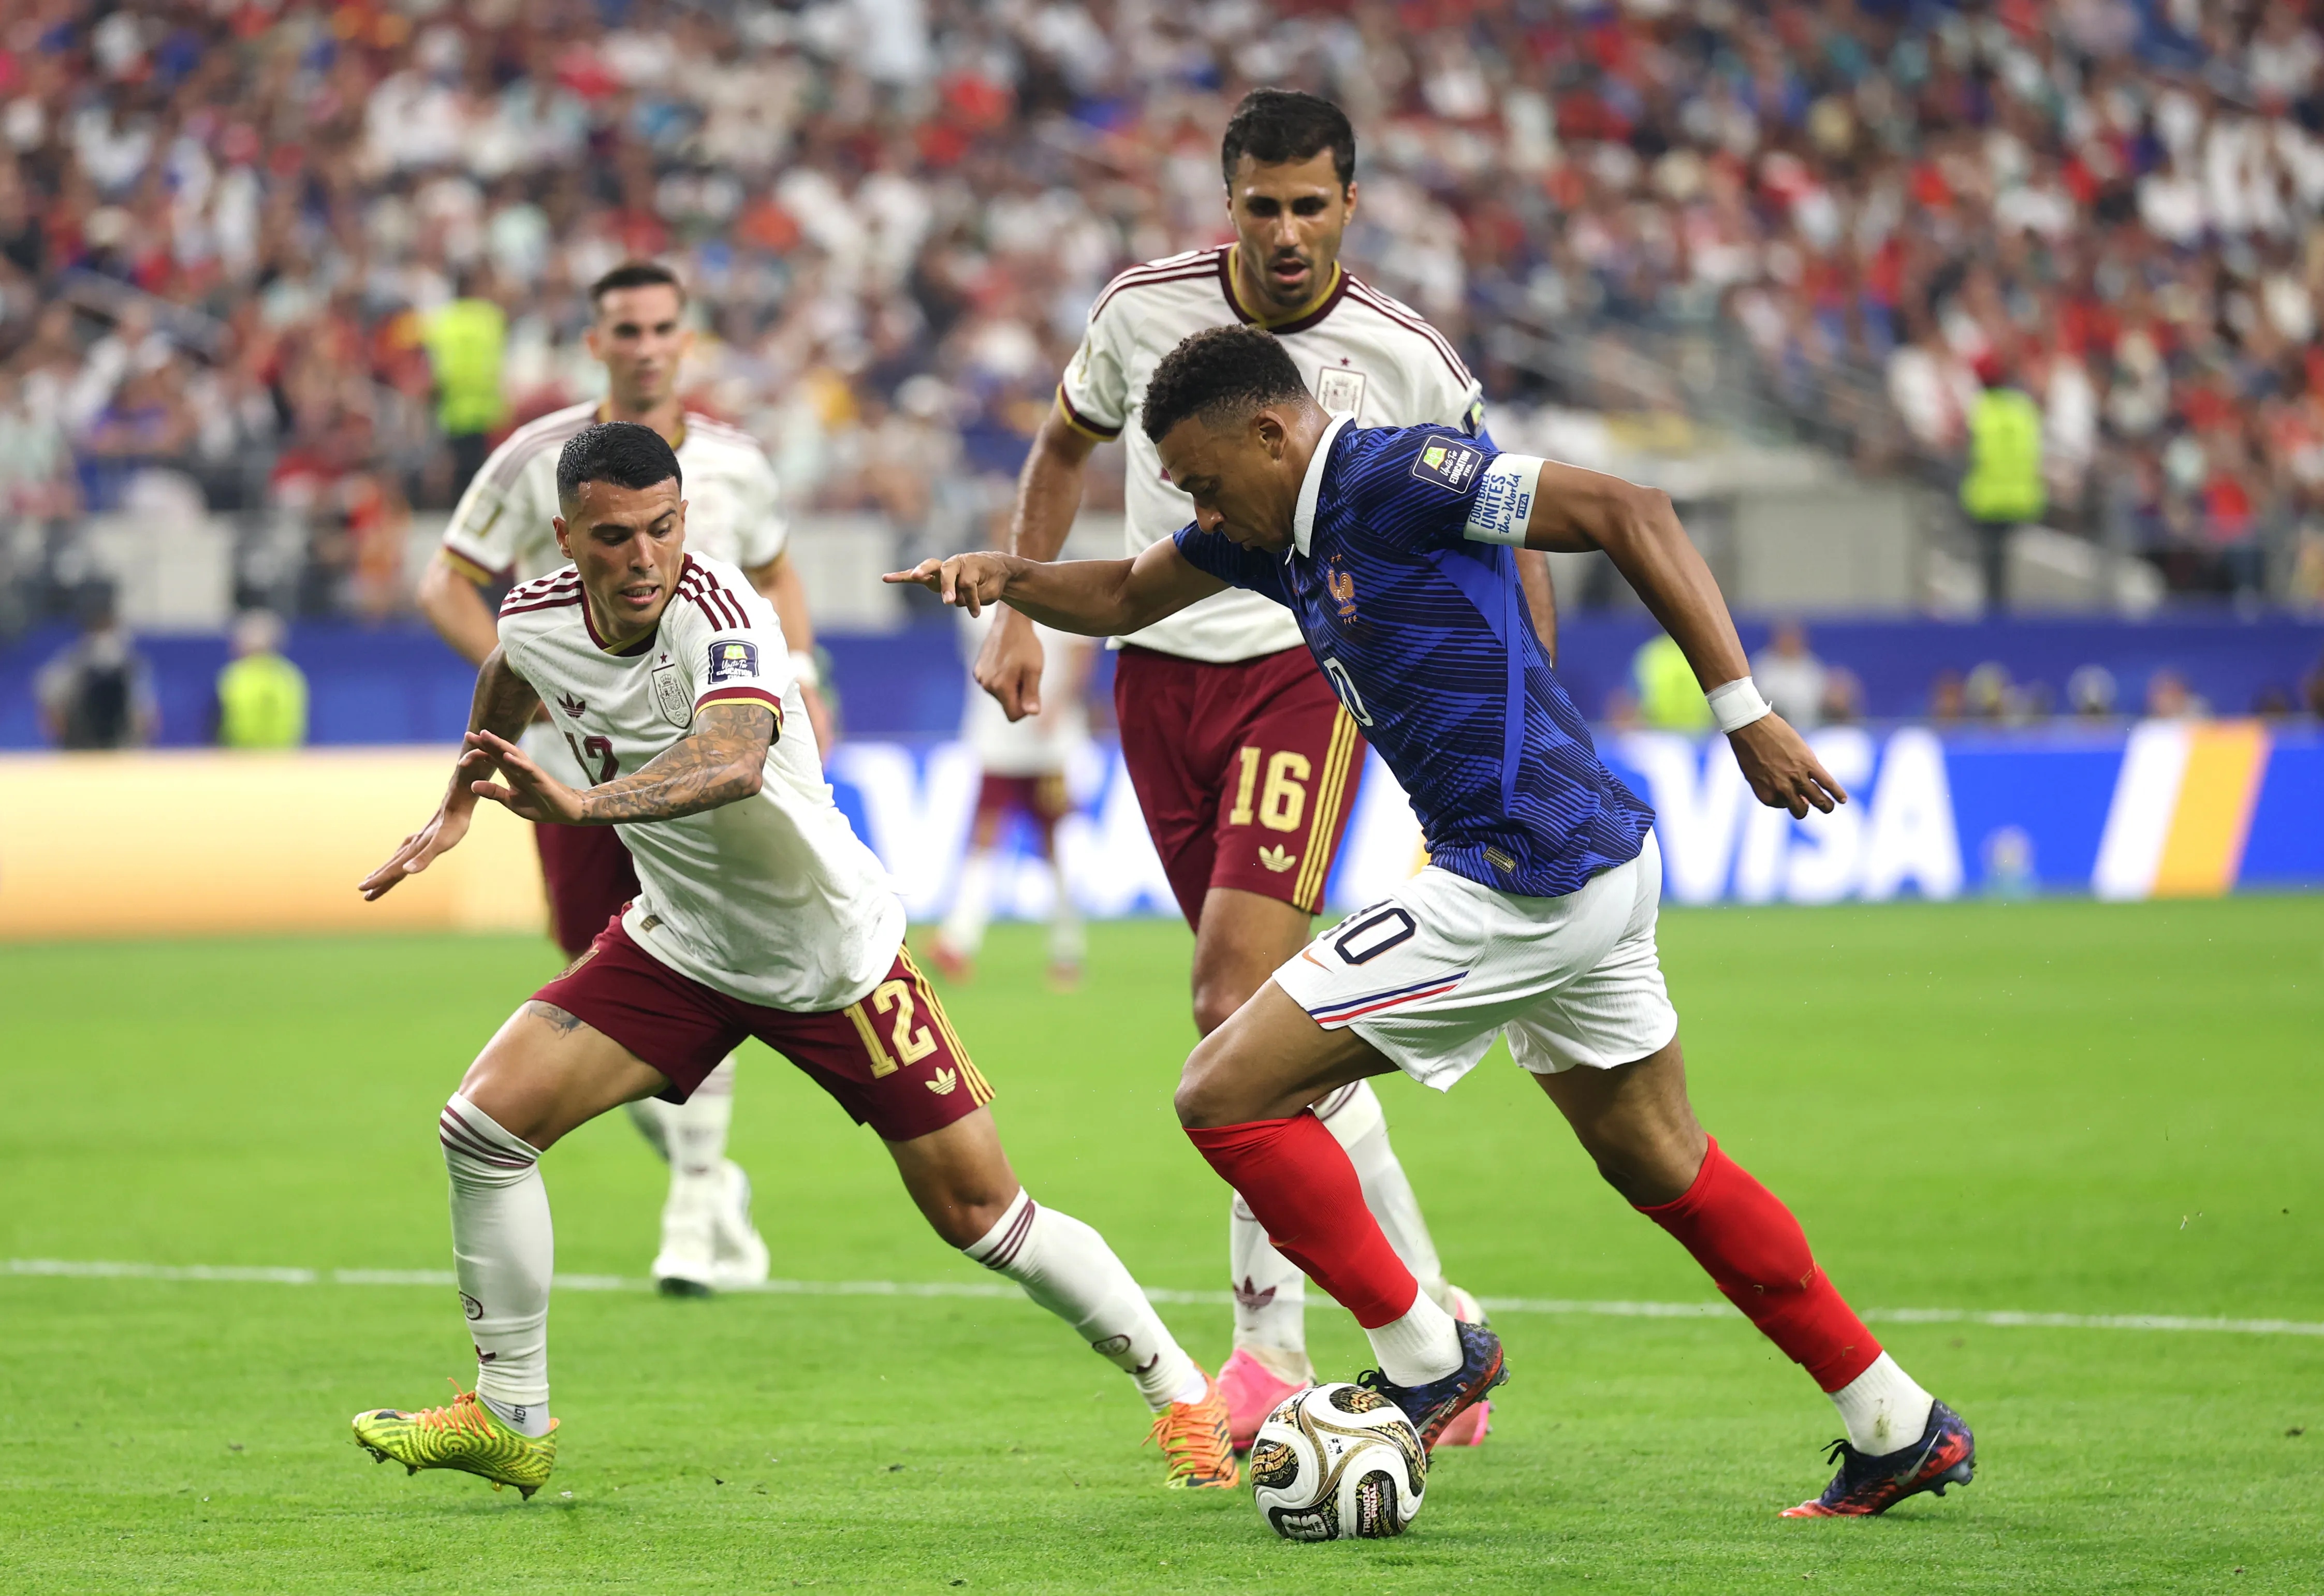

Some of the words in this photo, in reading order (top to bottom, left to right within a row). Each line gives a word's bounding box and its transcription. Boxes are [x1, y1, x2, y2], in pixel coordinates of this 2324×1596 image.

[1449, 450, 1471, 485] EDUCATION
[1463, 464, 1473, 476] FIFA
[1480, 474, 1506, 530] UNITES
[1502, 473, 1522, 511] World
[1517, 496, 1528, 517] FIFA
[1497, 514, 1511, 534] the
[563, 731, 620, 787] 12
[1229, 745, 1312, 833] 16
[1619, 726, 1963, 905] VISA
[842, 978, 938, 1079] 12
[1362, 1485, 1371, 1534] TRIONDA
[1369, 1483, 1378, 1518] FINAL
